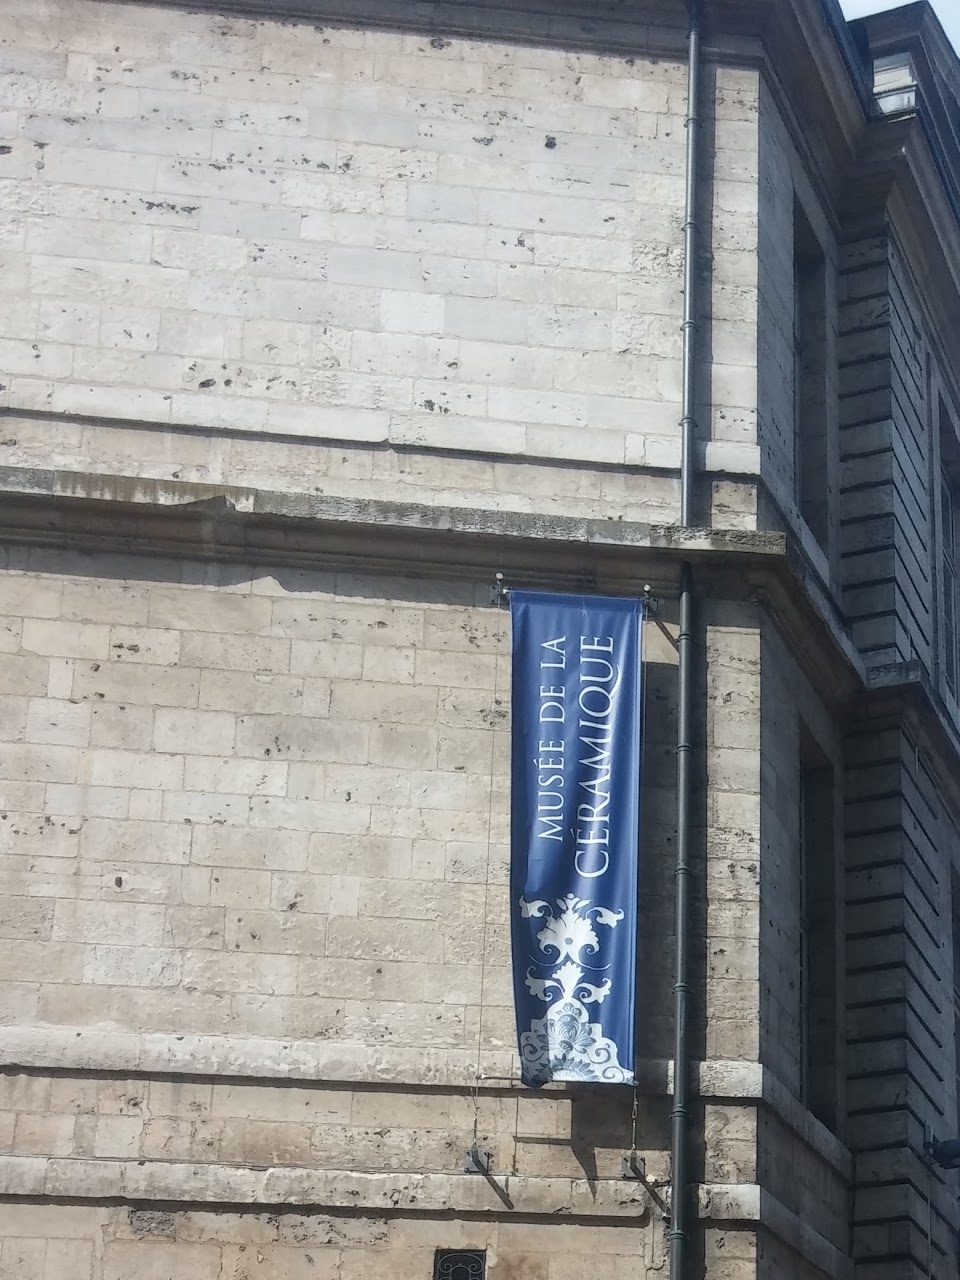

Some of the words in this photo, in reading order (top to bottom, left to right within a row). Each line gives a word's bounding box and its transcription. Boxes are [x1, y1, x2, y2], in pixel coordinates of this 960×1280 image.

[540, 634, 567, 670] LA
[539, 685, 566, 724] DE
[533, 739, 565, 842] MUSÉE
[570, 635, 622, 878] CÉRAMIQUE
